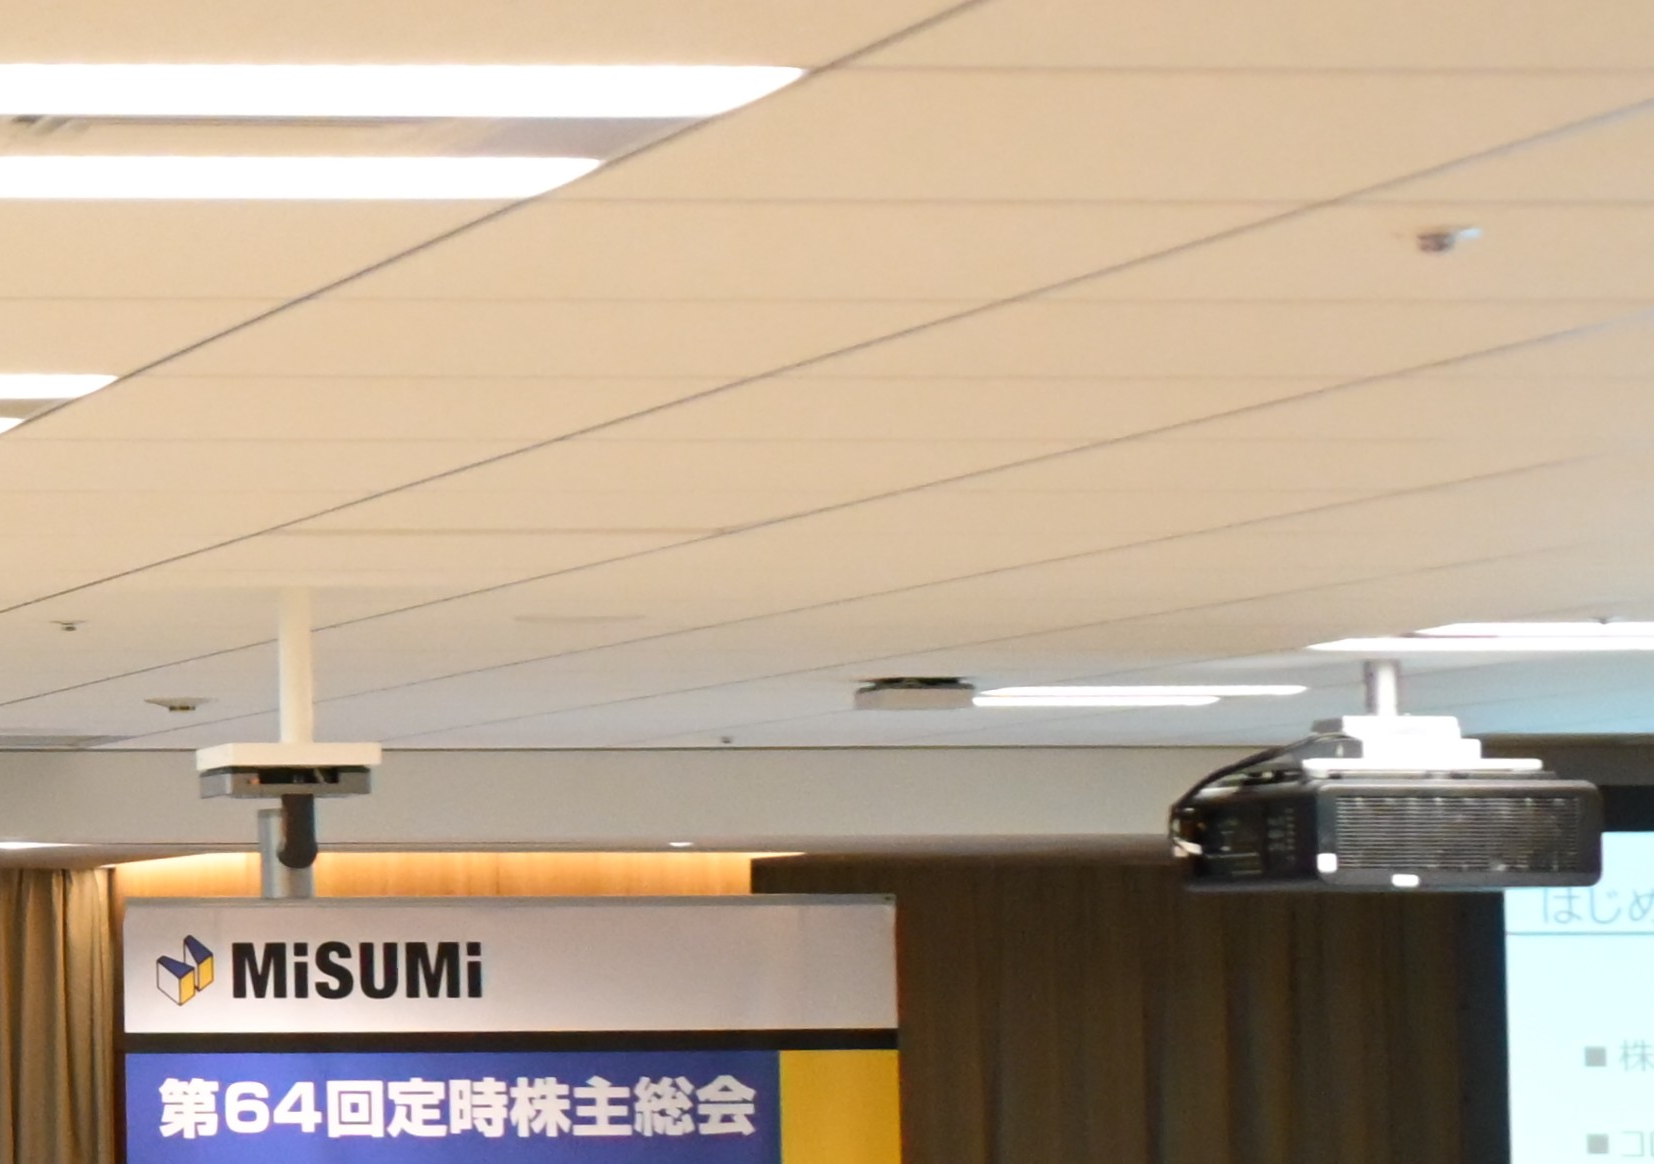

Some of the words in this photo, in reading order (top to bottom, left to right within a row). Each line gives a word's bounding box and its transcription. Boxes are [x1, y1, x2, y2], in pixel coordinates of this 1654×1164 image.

[232, 942, 483, 1000] MiSUMi
[159, 1076, 758, 1138] 第64回定時株主総会
